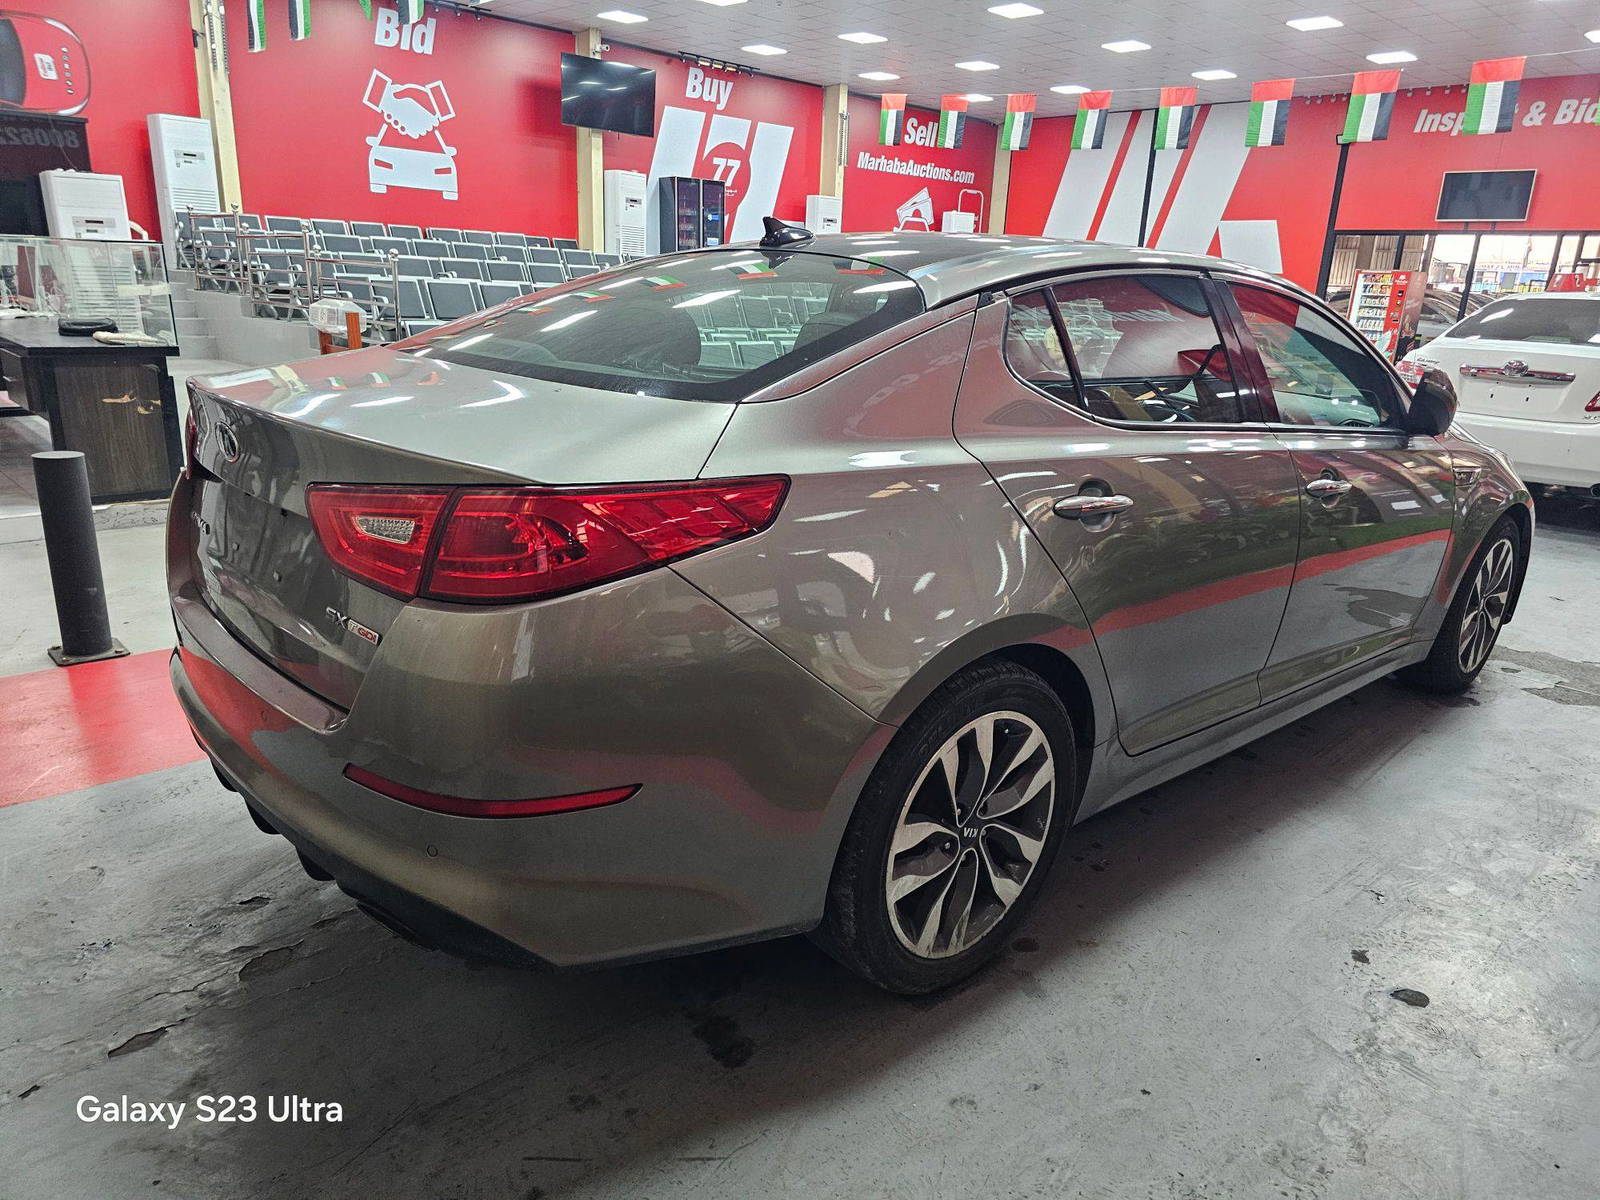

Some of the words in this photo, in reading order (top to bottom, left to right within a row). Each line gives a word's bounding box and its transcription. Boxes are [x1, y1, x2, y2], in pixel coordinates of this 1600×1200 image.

[374, 7, 437, 55] Bid
[685, 67, 734, 111] Buy
[1522, 101, 1546, 127] &
[904, 117, 939, 148] Sell
[713, 157, 741, 187] 77
[857, 151, 975, 184] MarhabaAuctions.com
[963, 827, 979, 838] KIA
